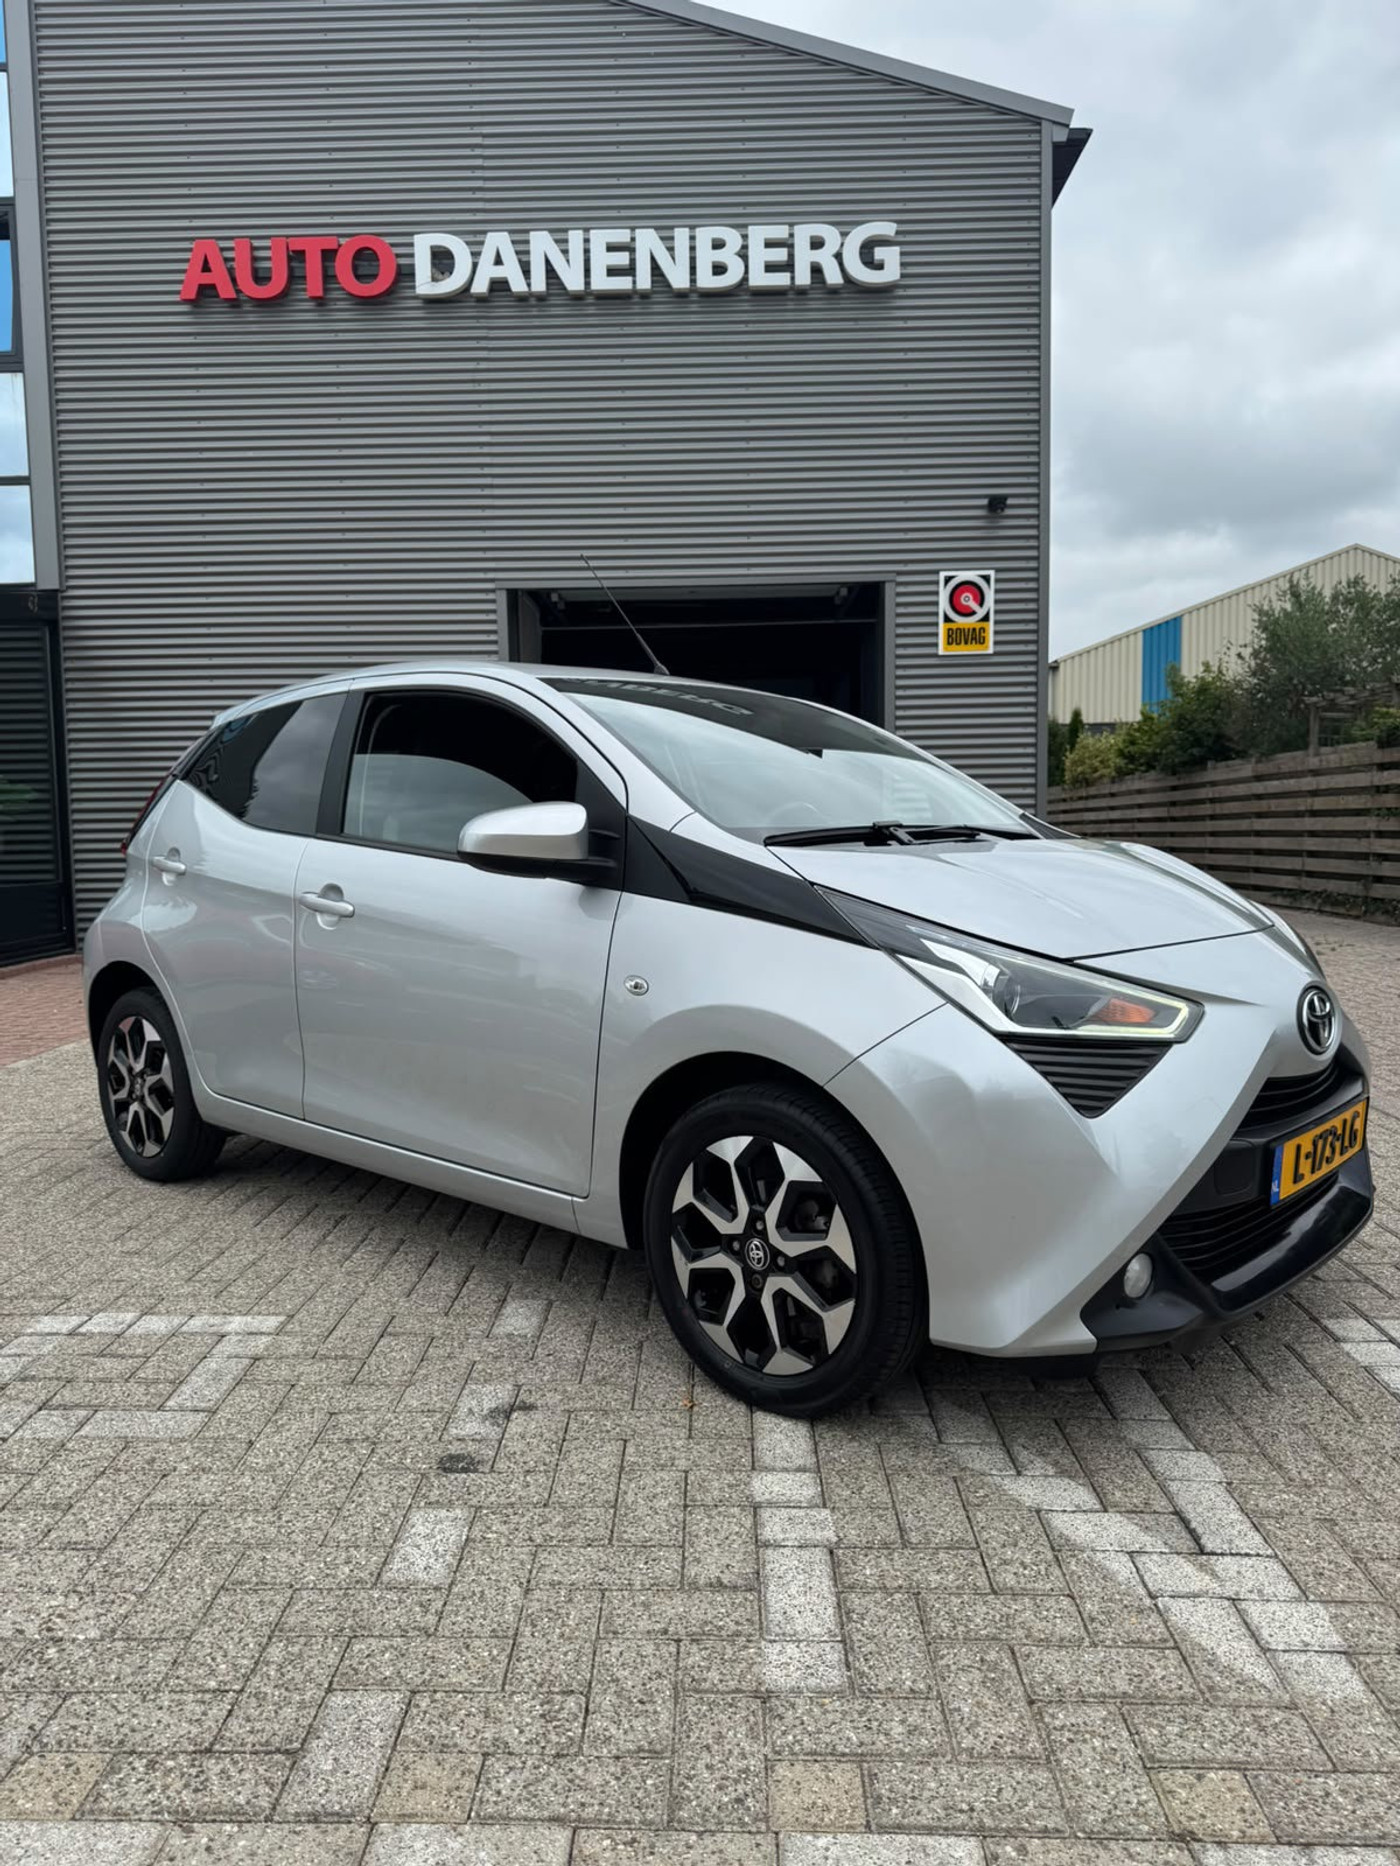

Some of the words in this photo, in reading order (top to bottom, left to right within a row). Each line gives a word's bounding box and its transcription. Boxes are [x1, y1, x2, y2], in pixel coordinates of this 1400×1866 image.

[180, 234, 397, 301] AUTO
[413, 221, 901, 298] DANENBERG
[946, 626, 986, 646] BOVAG
[1293, 1110, 1360, 1184] L-173-LG
